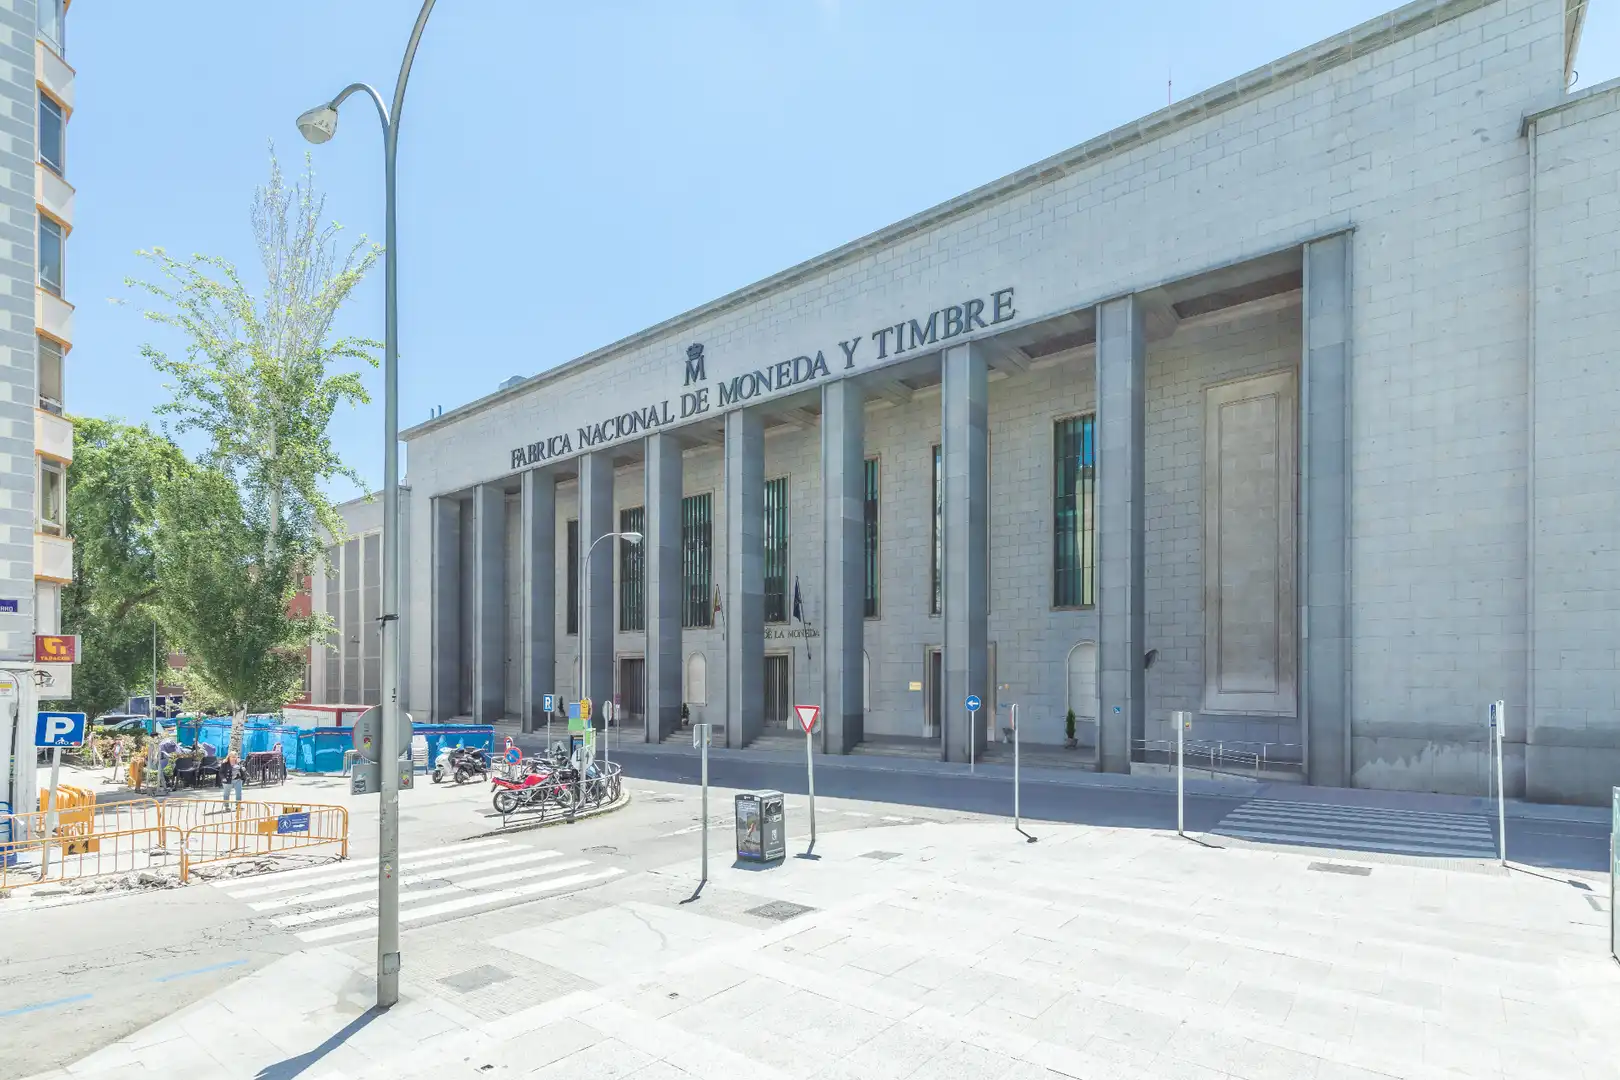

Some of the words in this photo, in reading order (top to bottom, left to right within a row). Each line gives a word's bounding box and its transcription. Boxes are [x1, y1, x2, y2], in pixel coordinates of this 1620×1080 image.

[510, 432, 573, 470] FABRICA
[576, 400, 675, 450] NACIONAL
[679, 387, 710, 419] DE
[717, 349, 832, 408] MONEDA
[838, 336, 862, 370] Y
[871, 286, 1017, 360] TIMBRE
[44, 716, 75, 743] P
